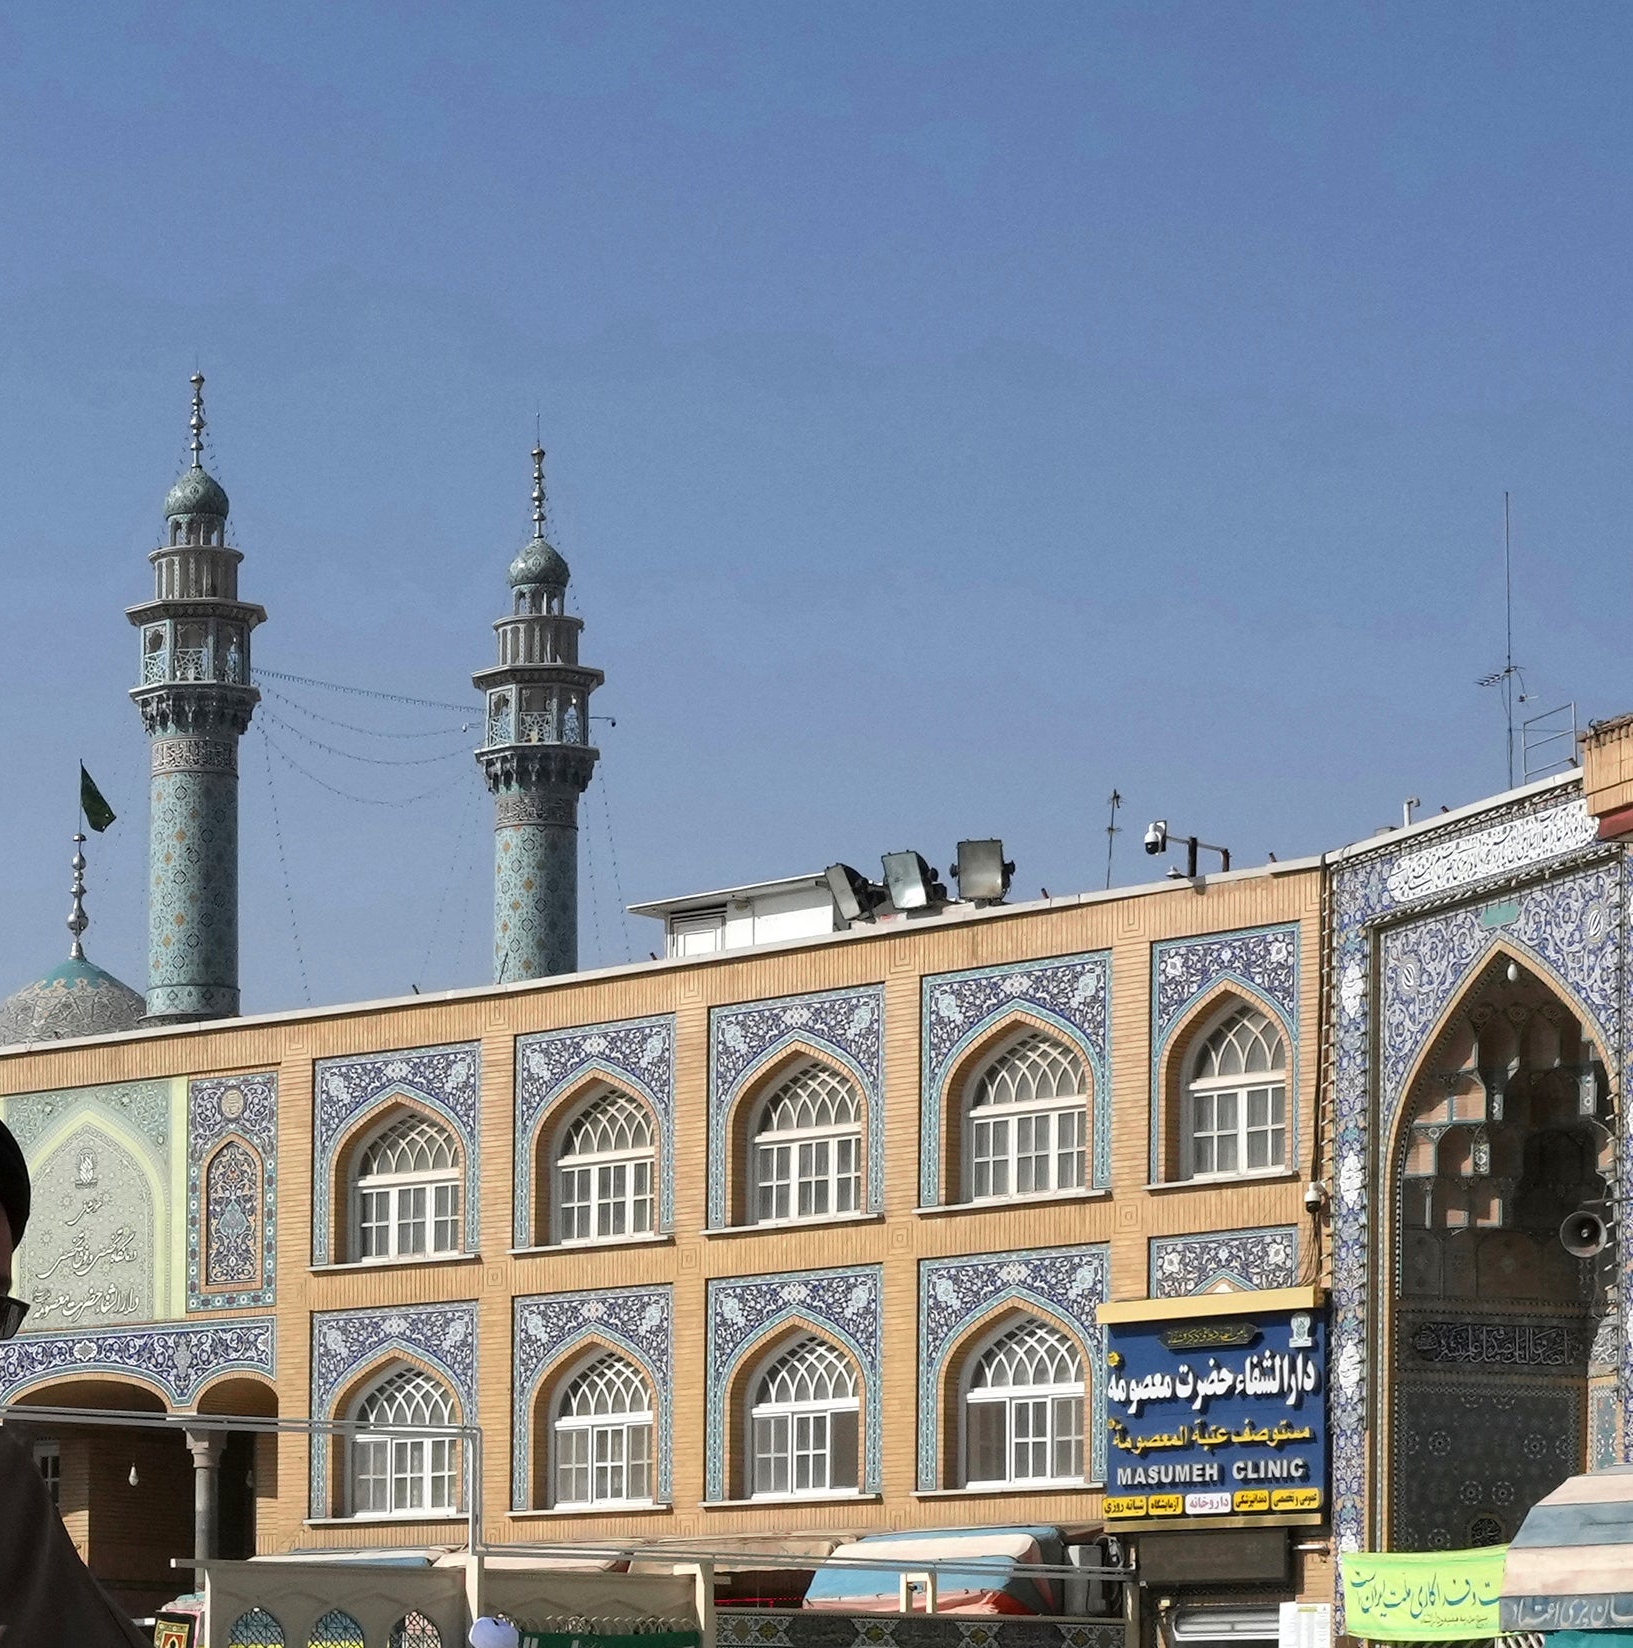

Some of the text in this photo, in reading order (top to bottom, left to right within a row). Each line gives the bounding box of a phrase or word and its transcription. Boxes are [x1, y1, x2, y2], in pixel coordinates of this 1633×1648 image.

[62, 1287, 104, 1323] حضرت
[1108, 1373, 1174, 1415] معصومه
[1175, 1357, 1235, 1411] حضرت
[1230, 1418, 1312, 1448] مستوصف
[1117, 1457, 1305, 1486] MASUMEH CLINIC
[1104, 1499, 1145, 1514] شبانه روزی
[1150, 1496, 1180, 1512] آزمایشگاه
[1189, 1495, 1230, 1510] داروخانه
[1235, 1492, 1268, 1508] دندانپزشکی
[1274, 1495, 1295, 1507] تخصصی
